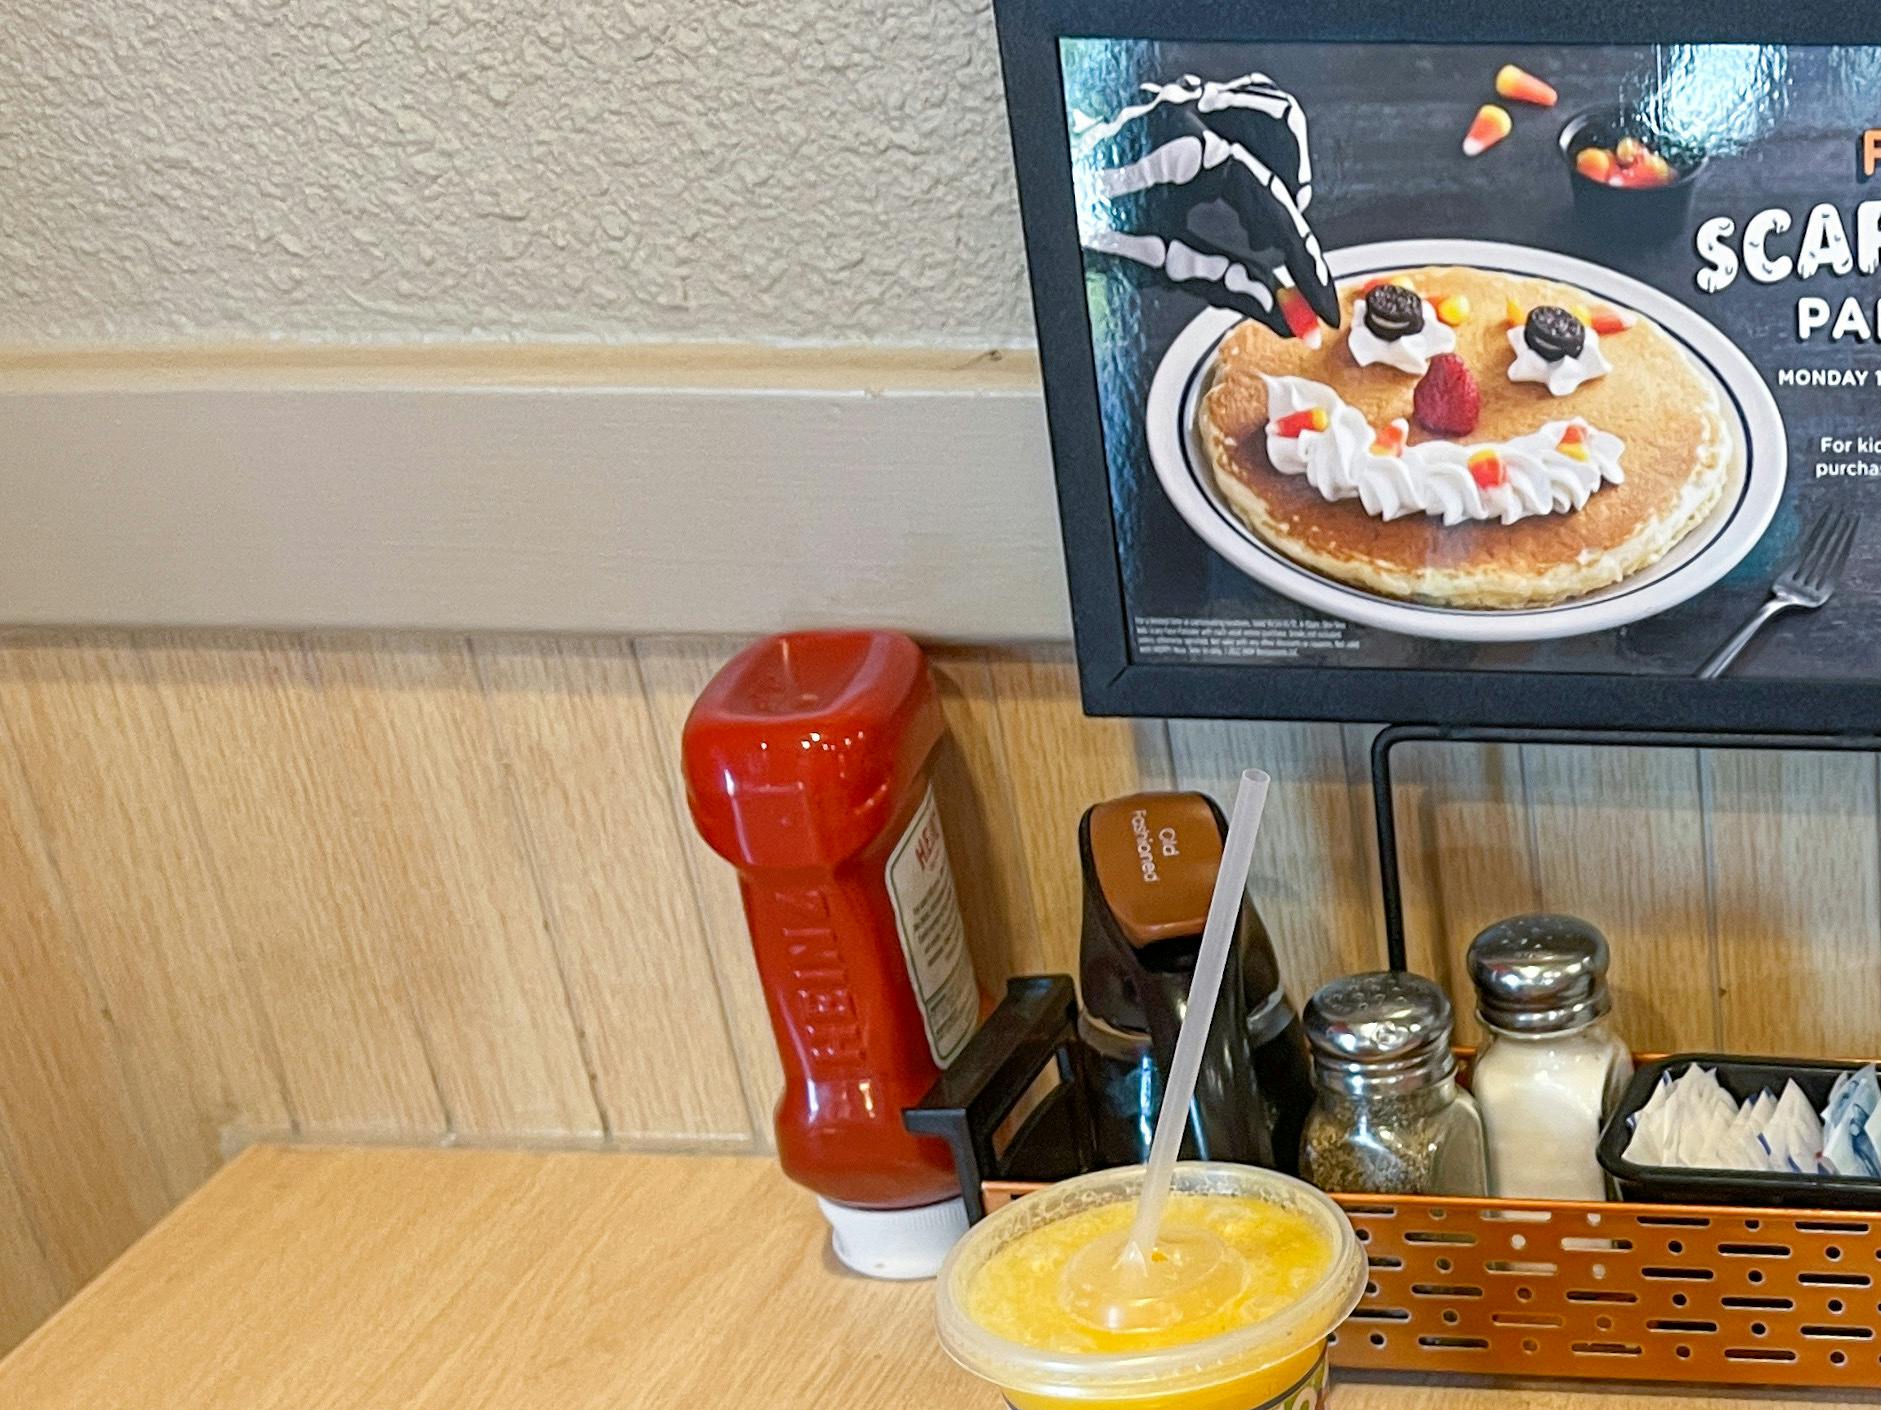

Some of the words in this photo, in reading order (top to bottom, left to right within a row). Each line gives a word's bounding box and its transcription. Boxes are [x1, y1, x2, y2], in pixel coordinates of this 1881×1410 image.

[1778, 369, 1868, 387] MONDAY
[1820, 437, 1852, 454] For
[1158, 827, 1180, 857] Old
